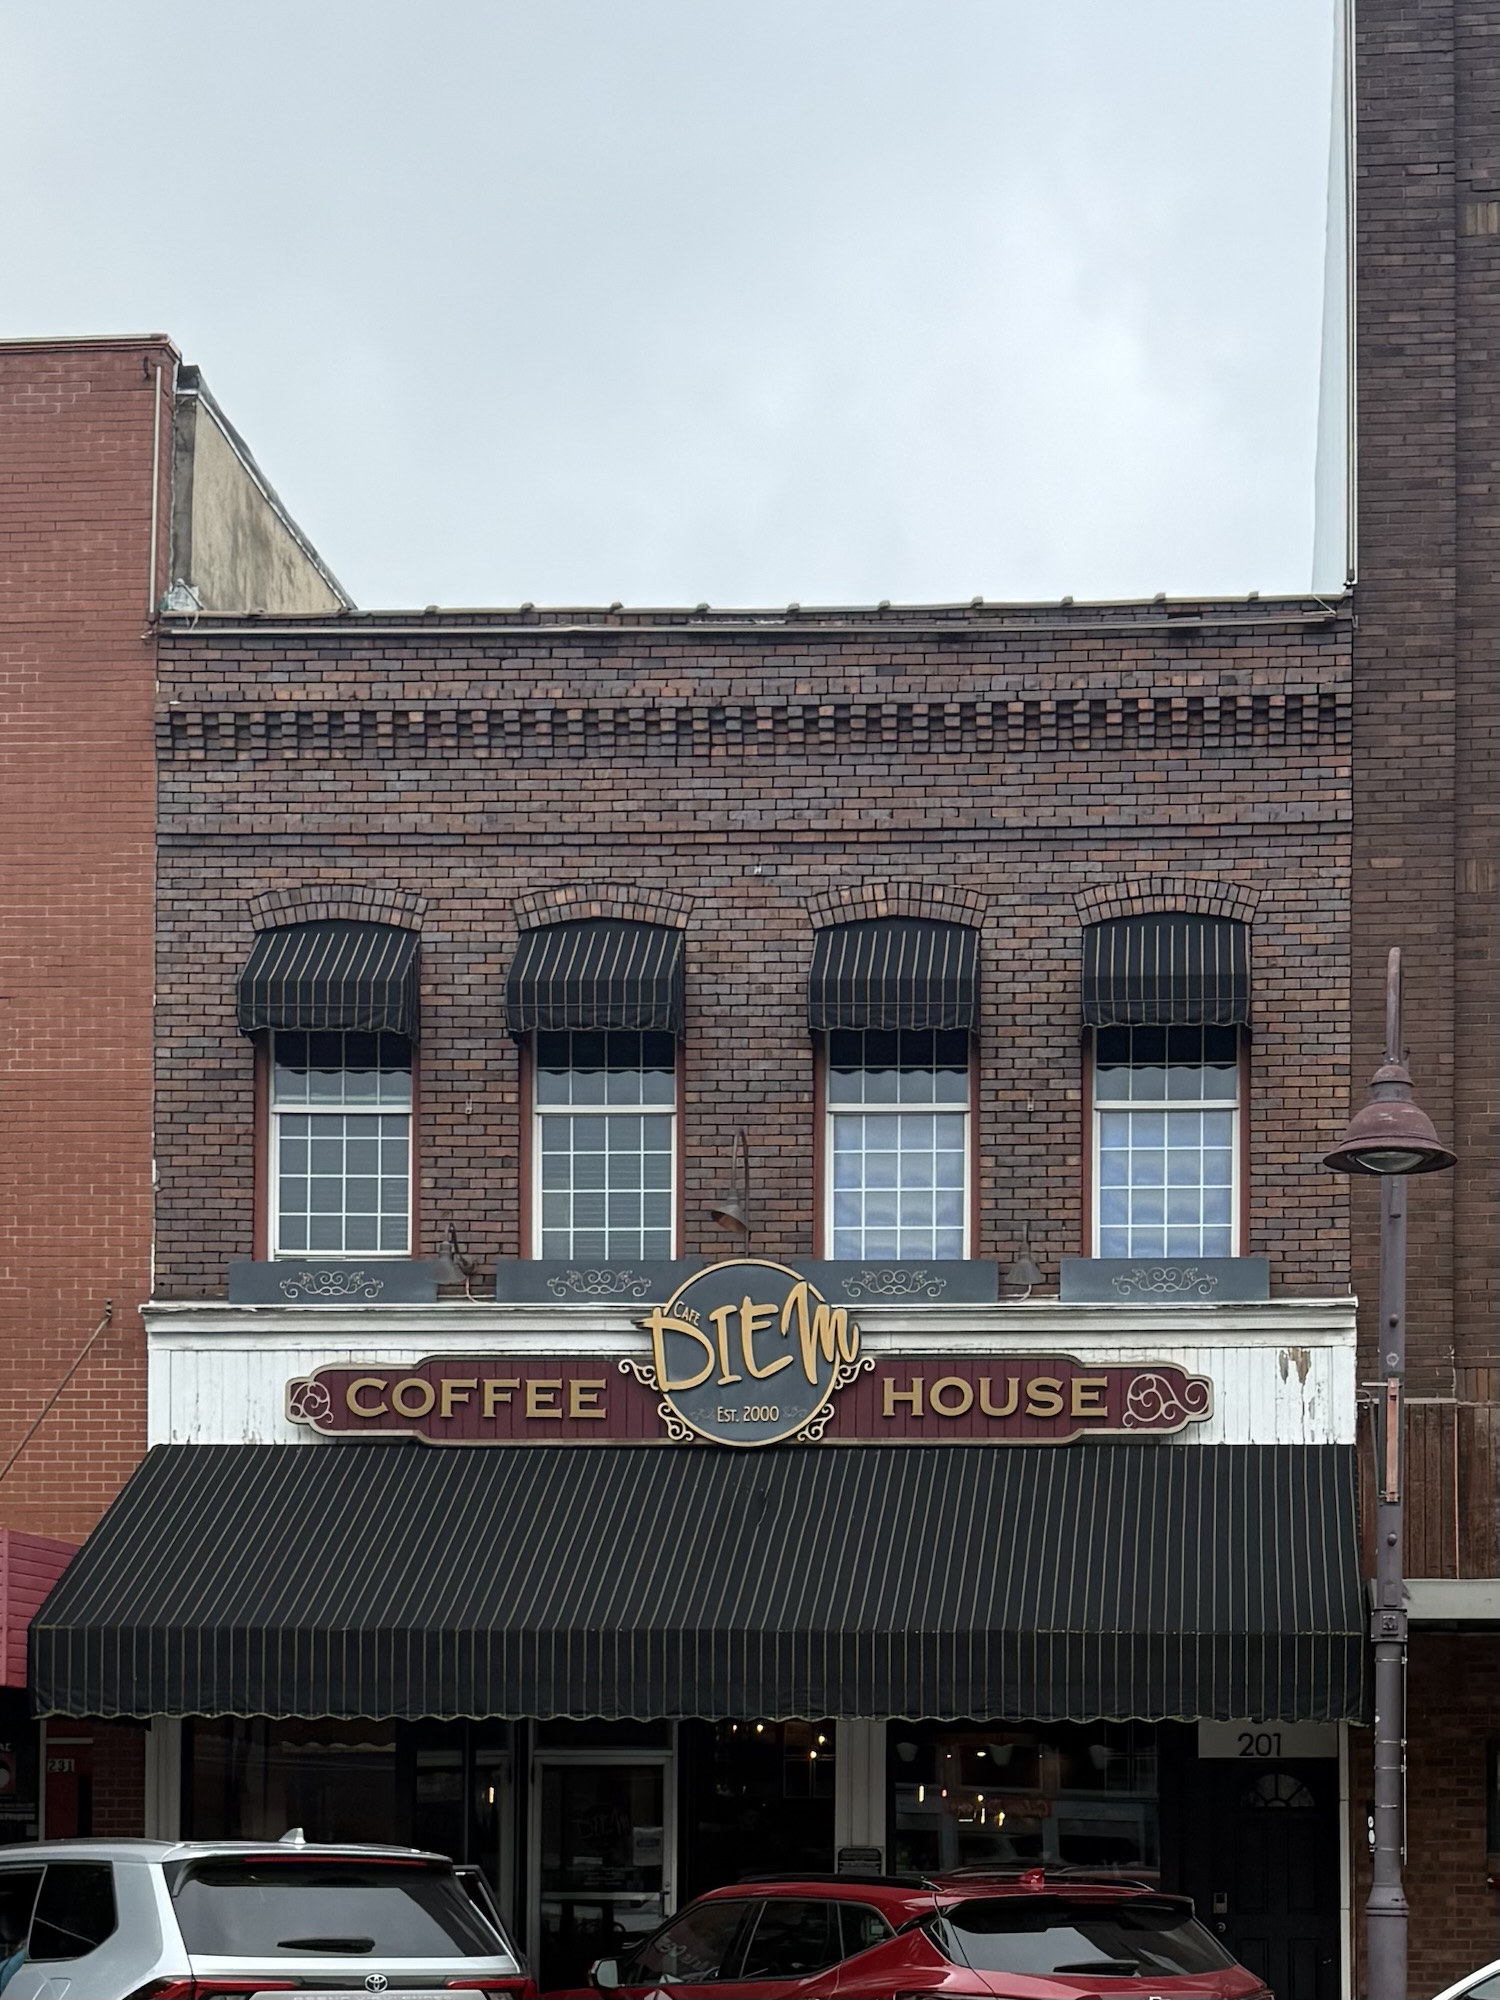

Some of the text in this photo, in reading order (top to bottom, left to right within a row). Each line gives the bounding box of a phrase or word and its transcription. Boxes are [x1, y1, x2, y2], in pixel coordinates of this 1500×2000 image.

[345, 1376, 608, 1420] COFFEE
[881, 1376, 1109, 1418] HOUSE
[743, 1405, 780, 1422] 2000
[1237, 1732, 1282, 1757] 201
[48, 1759, 74, 1773] 231
